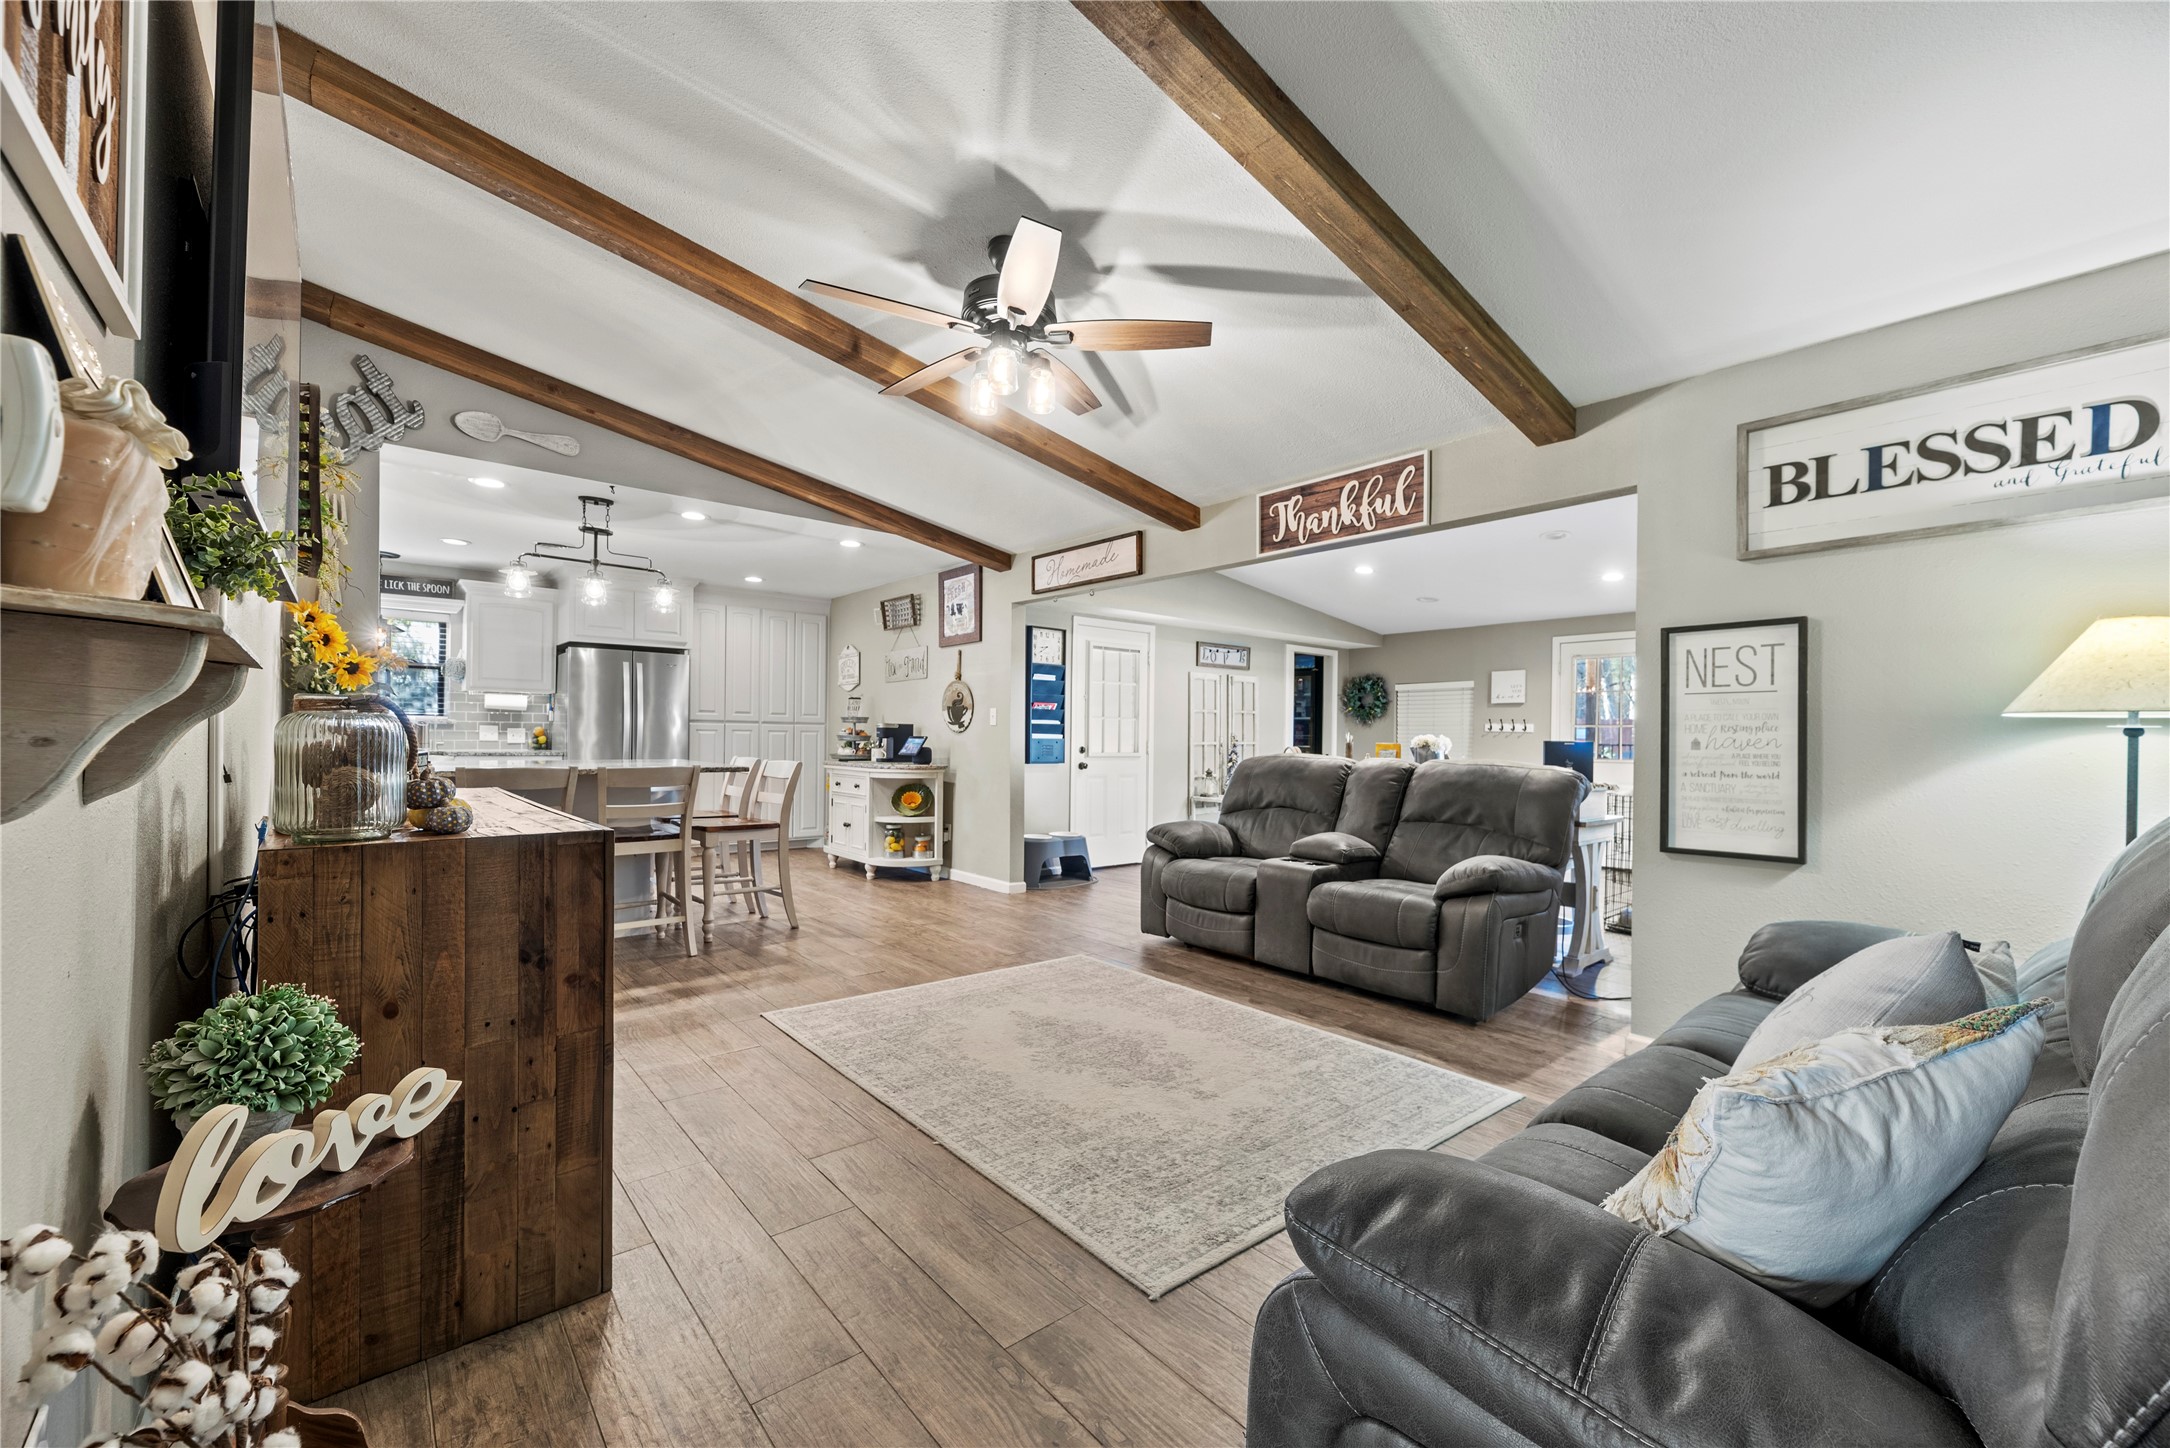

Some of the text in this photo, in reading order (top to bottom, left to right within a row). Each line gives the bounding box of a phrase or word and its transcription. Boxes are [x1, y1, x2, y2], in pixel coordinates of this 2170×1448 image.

[1763, 399, 2161, 508] BLESSED
[1994, 447, 2165, 488] and Grateful
[1269, 465, 1416, 544] Thankful
[1046, 540, 1119, 586] Homemade
[384, 579, 405, 591] LICK
[406, 581, 421, 592] THE
[422, 583, 450, 595] SPOON
[1686, 643, 1785, 689] NEST
[1684, 723, 1708, 734] HOME
[1705, 724, 1783, 751] haven
[1689, 782, 1736, 794] SANCTUARY
[155, 1067, 463, 1253] love
